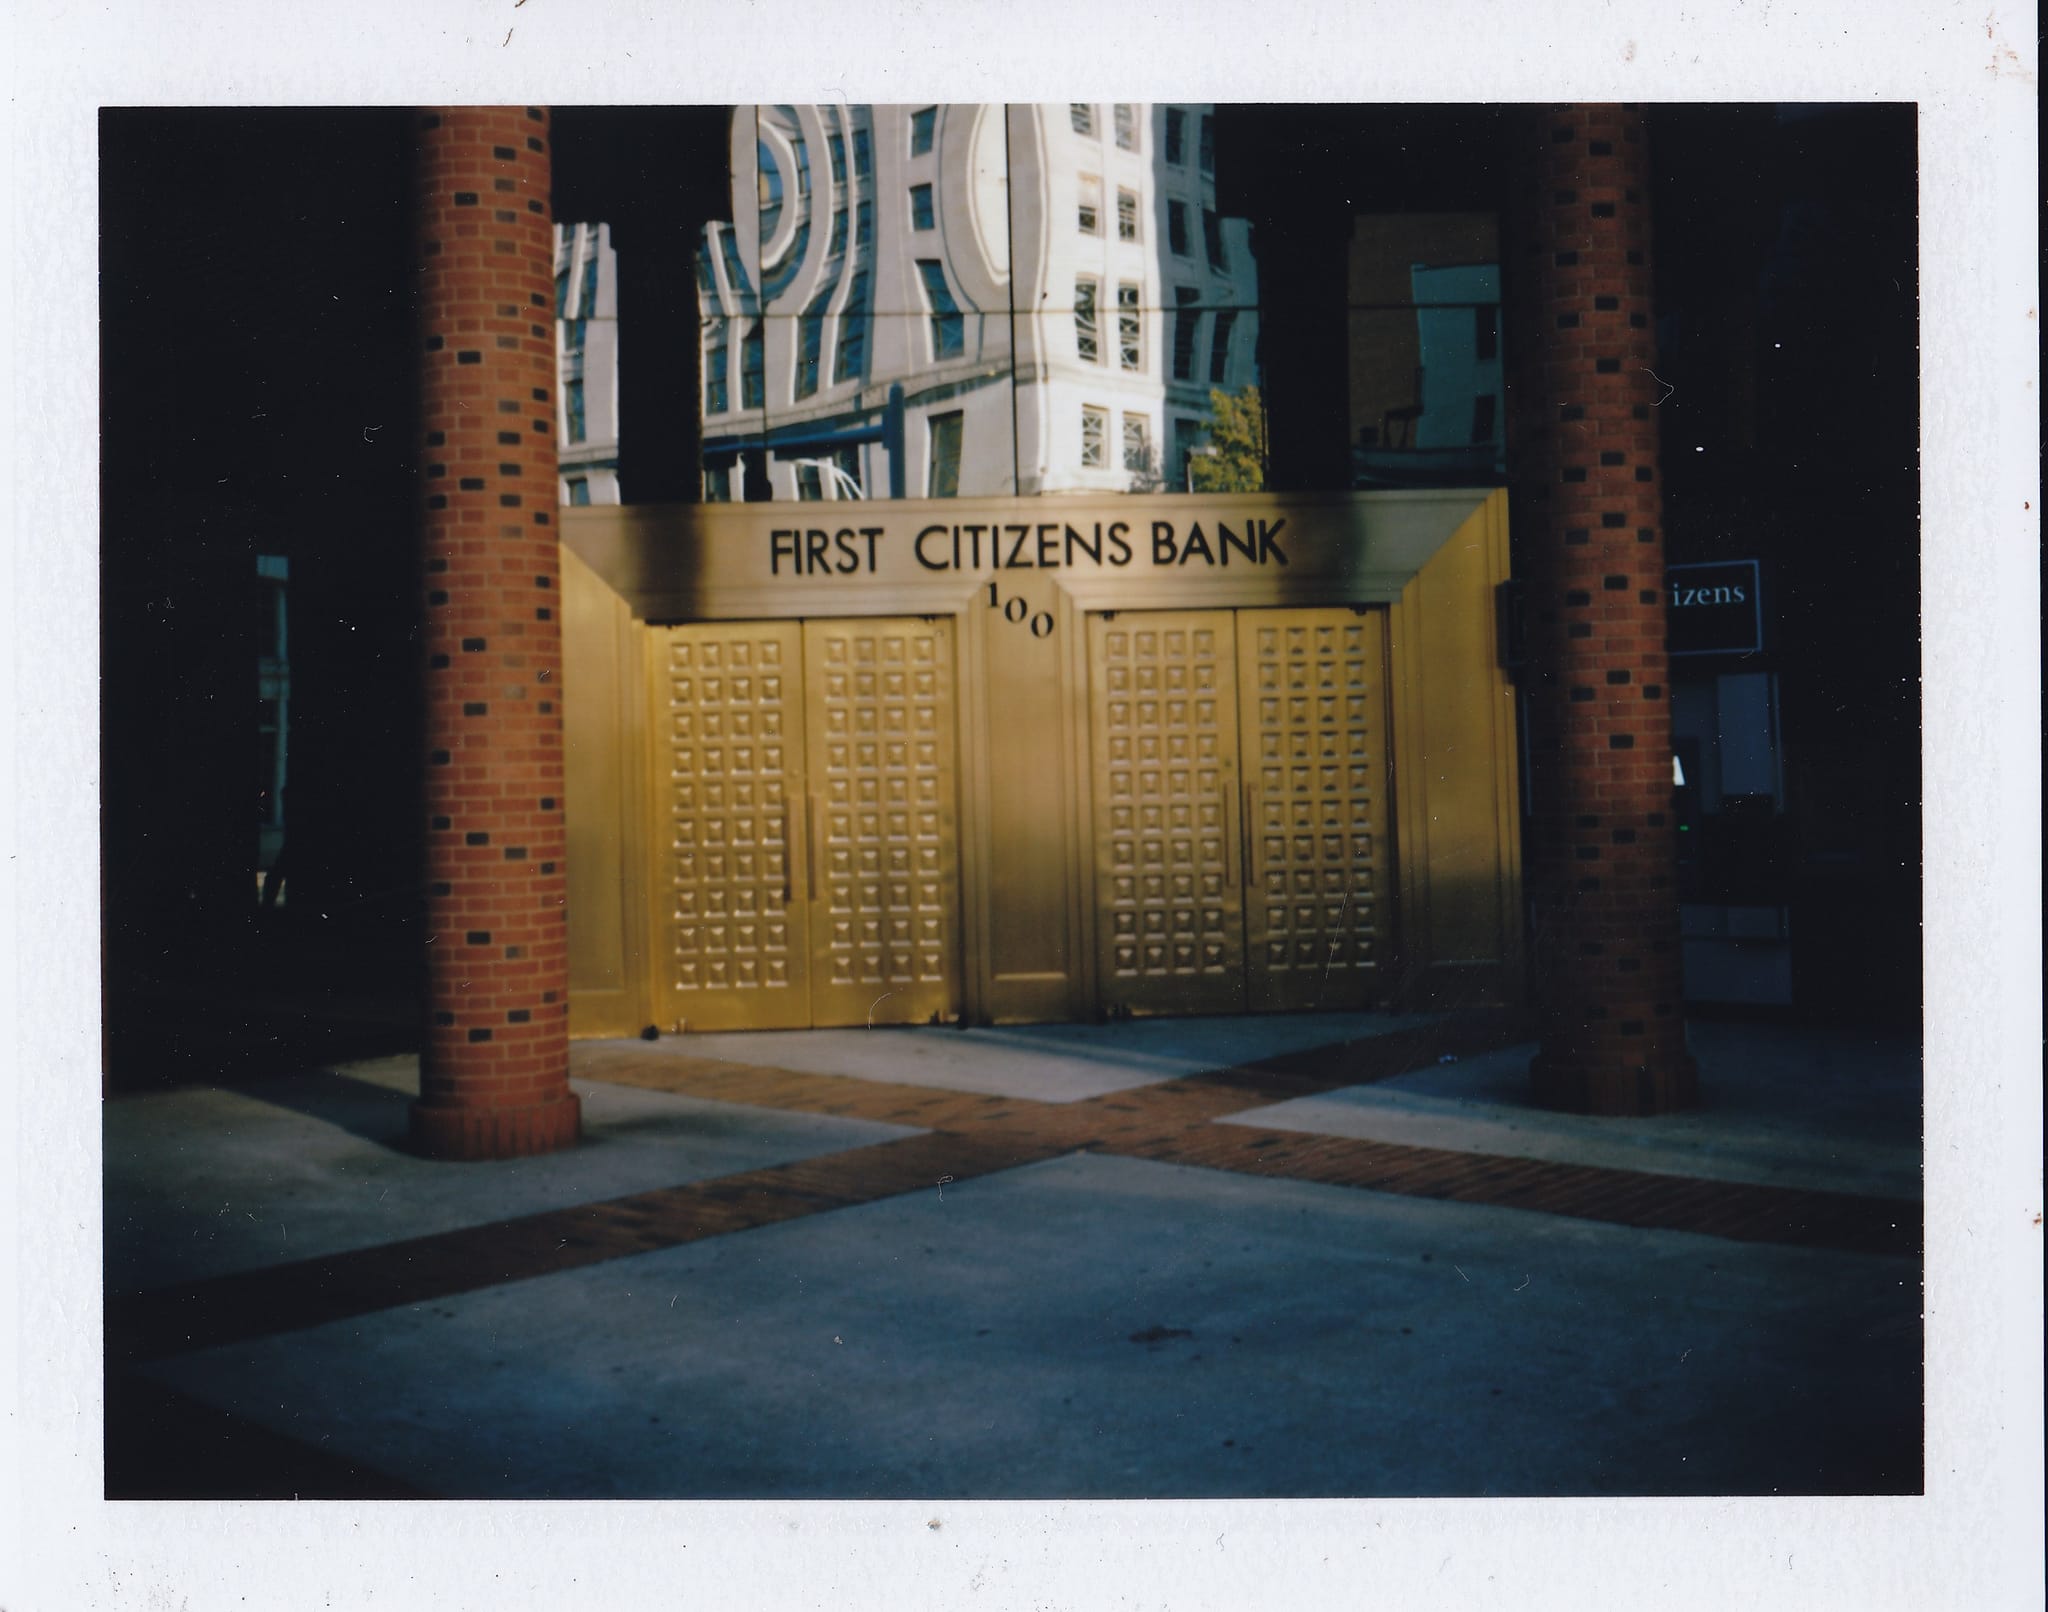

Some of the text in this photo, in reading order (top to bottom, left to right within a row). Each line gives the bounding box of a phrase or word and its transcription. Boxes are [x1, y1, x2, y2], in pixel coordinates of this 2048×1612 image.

[771, 519, 1289, 574] FIRST CITIZENS BANK
[988, 582, 1054, 638] 100
[1673, 582, 1745, 606] izens
